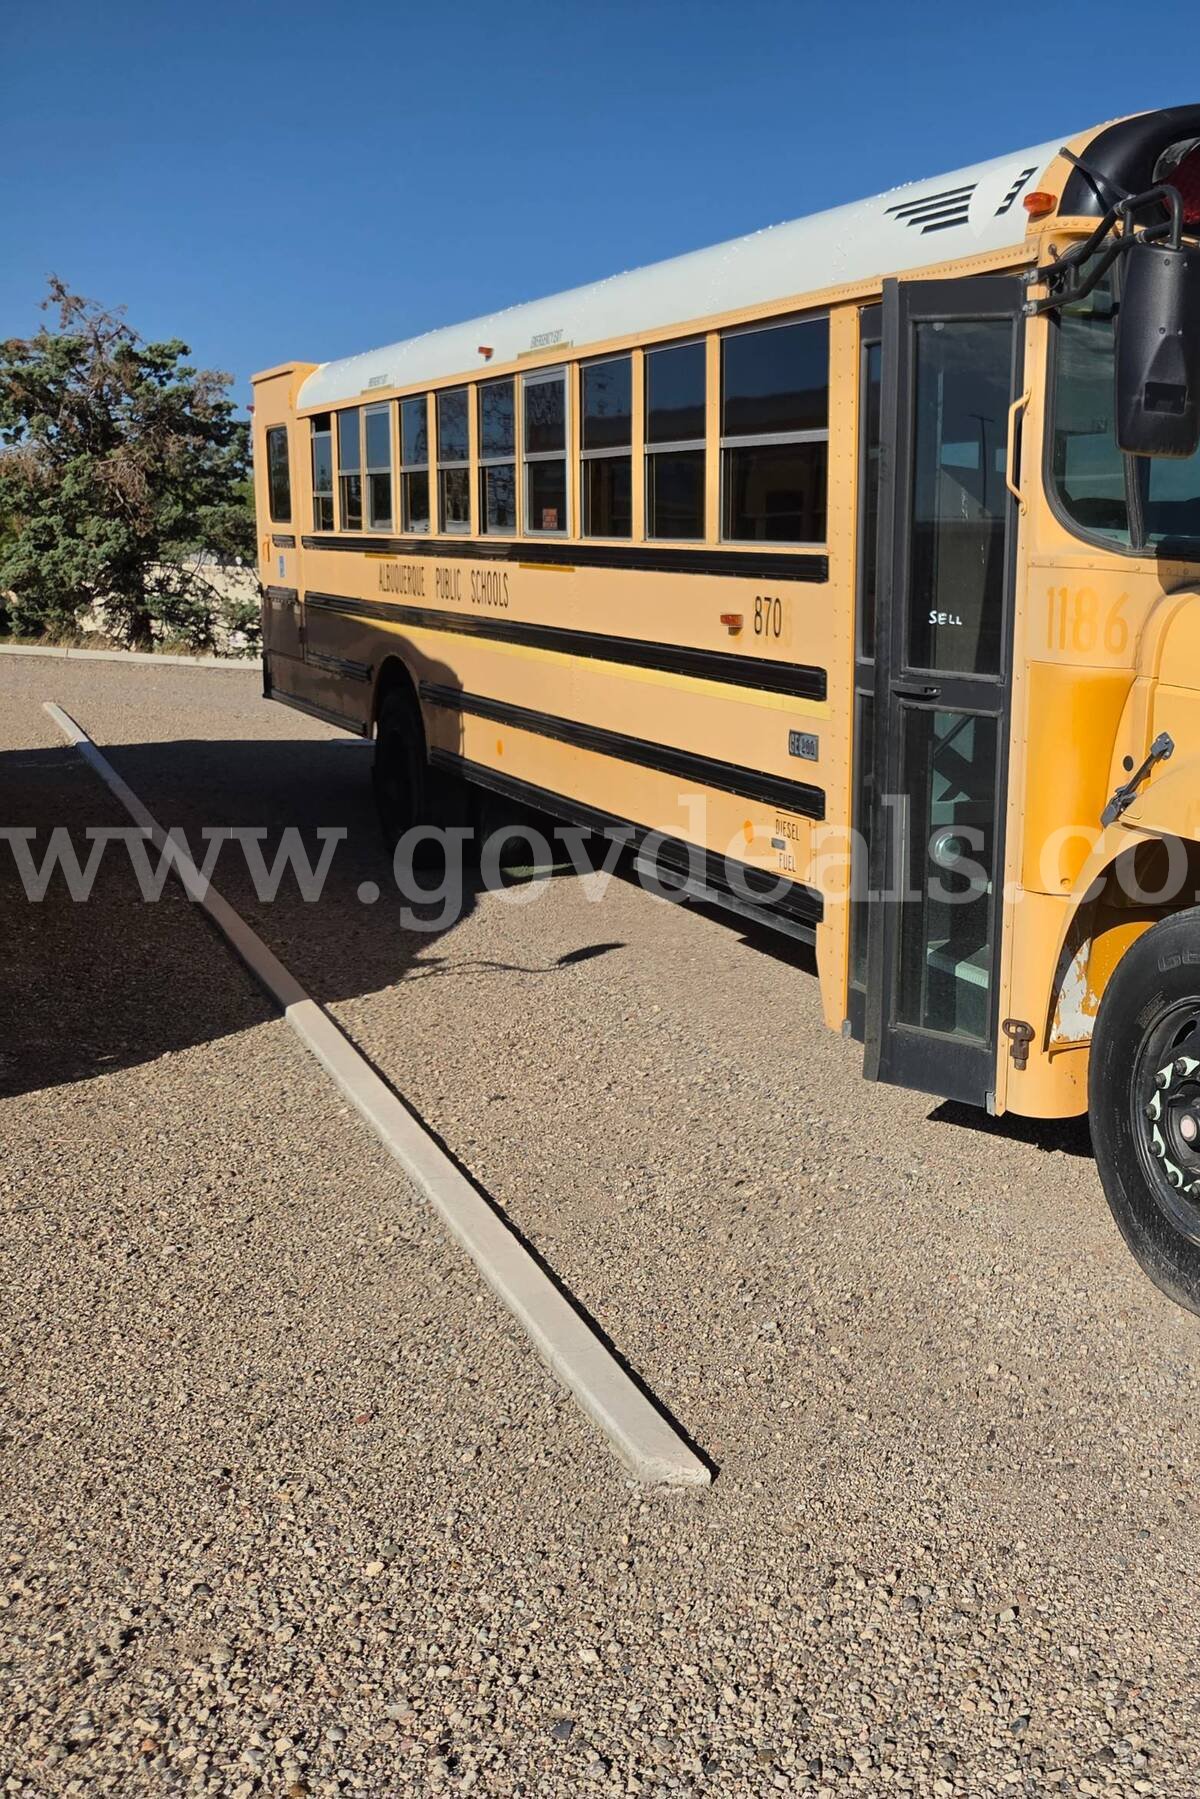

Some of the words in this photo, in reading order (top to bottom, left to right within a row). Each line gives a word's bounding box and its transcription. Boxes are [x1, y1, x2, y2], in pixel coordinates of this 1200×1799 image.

[435, 567, 462, 601] PUBLIC
[471, 569, 509, 608] SCHOOLS
[754, 595, 782, 638] 870
[928, 609, 963, 625] SELL
[1047, 586, 1129, 656] 1186
[776, 819, 800, 841] DIESEL
[779, 853, 797, 872] FUEL
